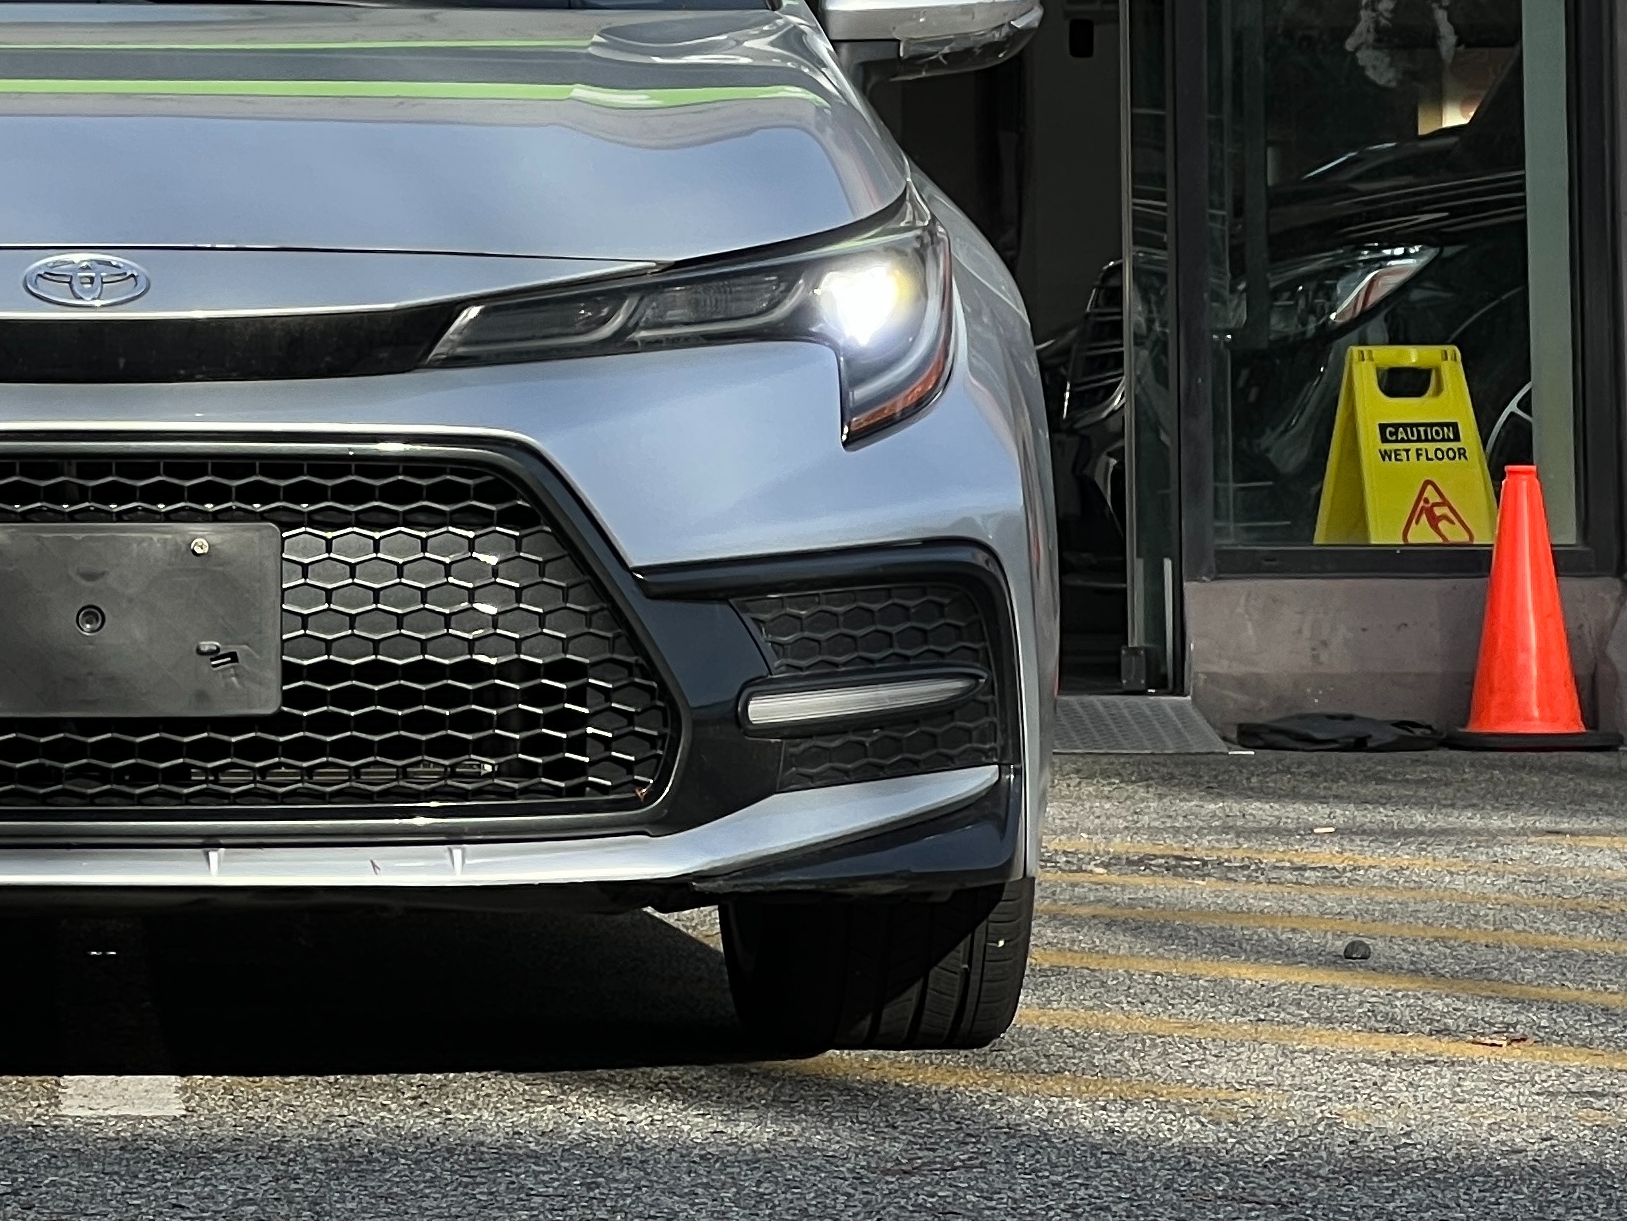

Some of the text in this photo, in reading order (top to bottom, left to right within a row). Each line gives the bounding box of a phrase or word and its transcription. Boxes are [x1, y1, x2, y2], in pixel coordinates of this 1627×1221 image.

[1385, 425, 1454, 441] CAUTION
[1378, 447, 1468, 462] WET FLOOR
